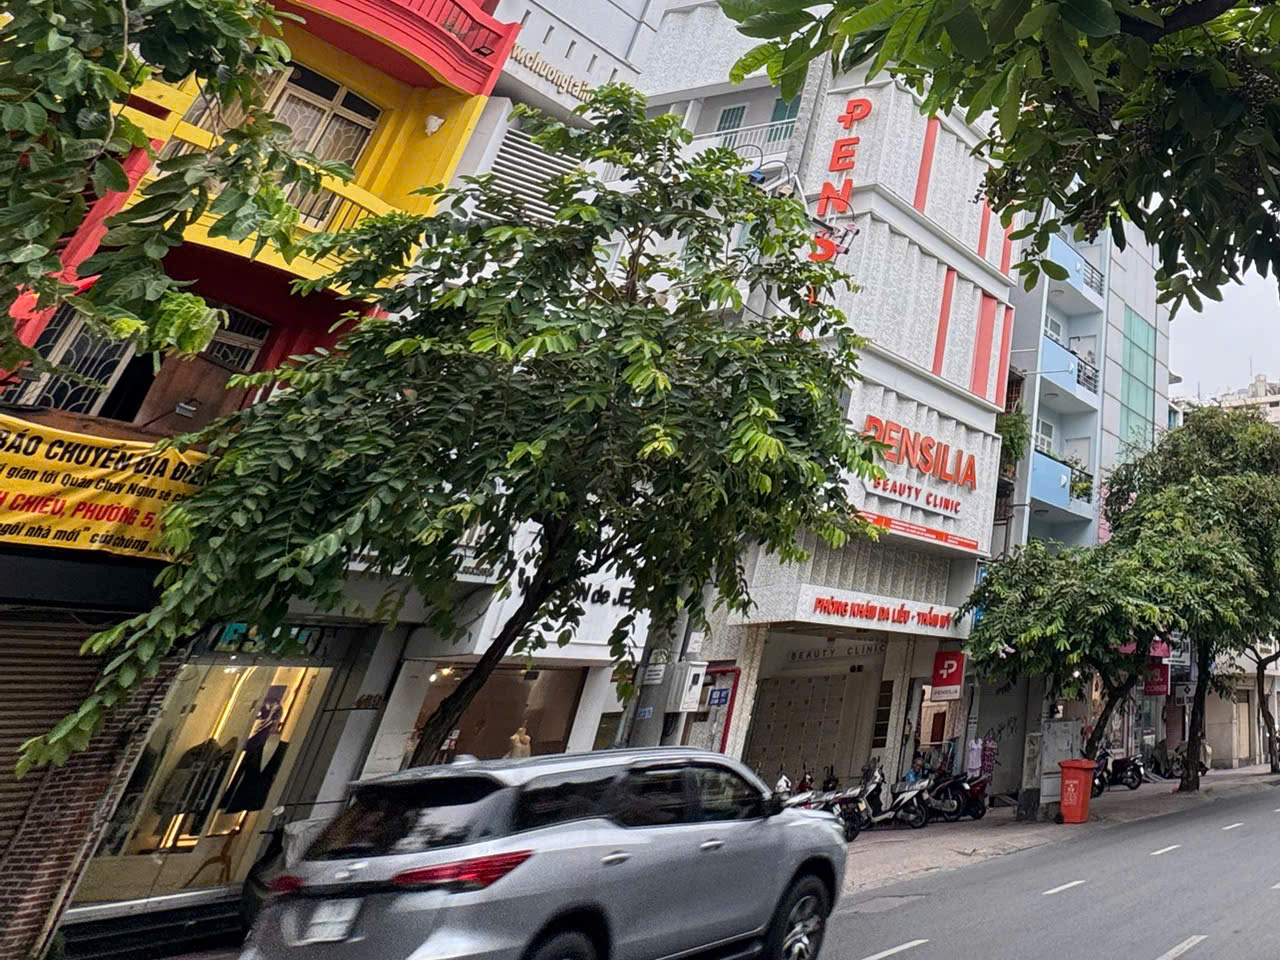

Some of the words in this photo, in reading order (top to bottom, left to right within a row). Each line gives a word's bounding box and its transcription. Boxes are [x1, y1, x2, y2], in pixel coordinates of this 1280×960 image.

[808, 98, 873, 264] PENS
[6, 465, 37, 482] gian
[861, 415, 977, 491] PENSILIA
[873, 477, 922, 500] BEAUTY
[926, 492, 961, 515] CLINIC
